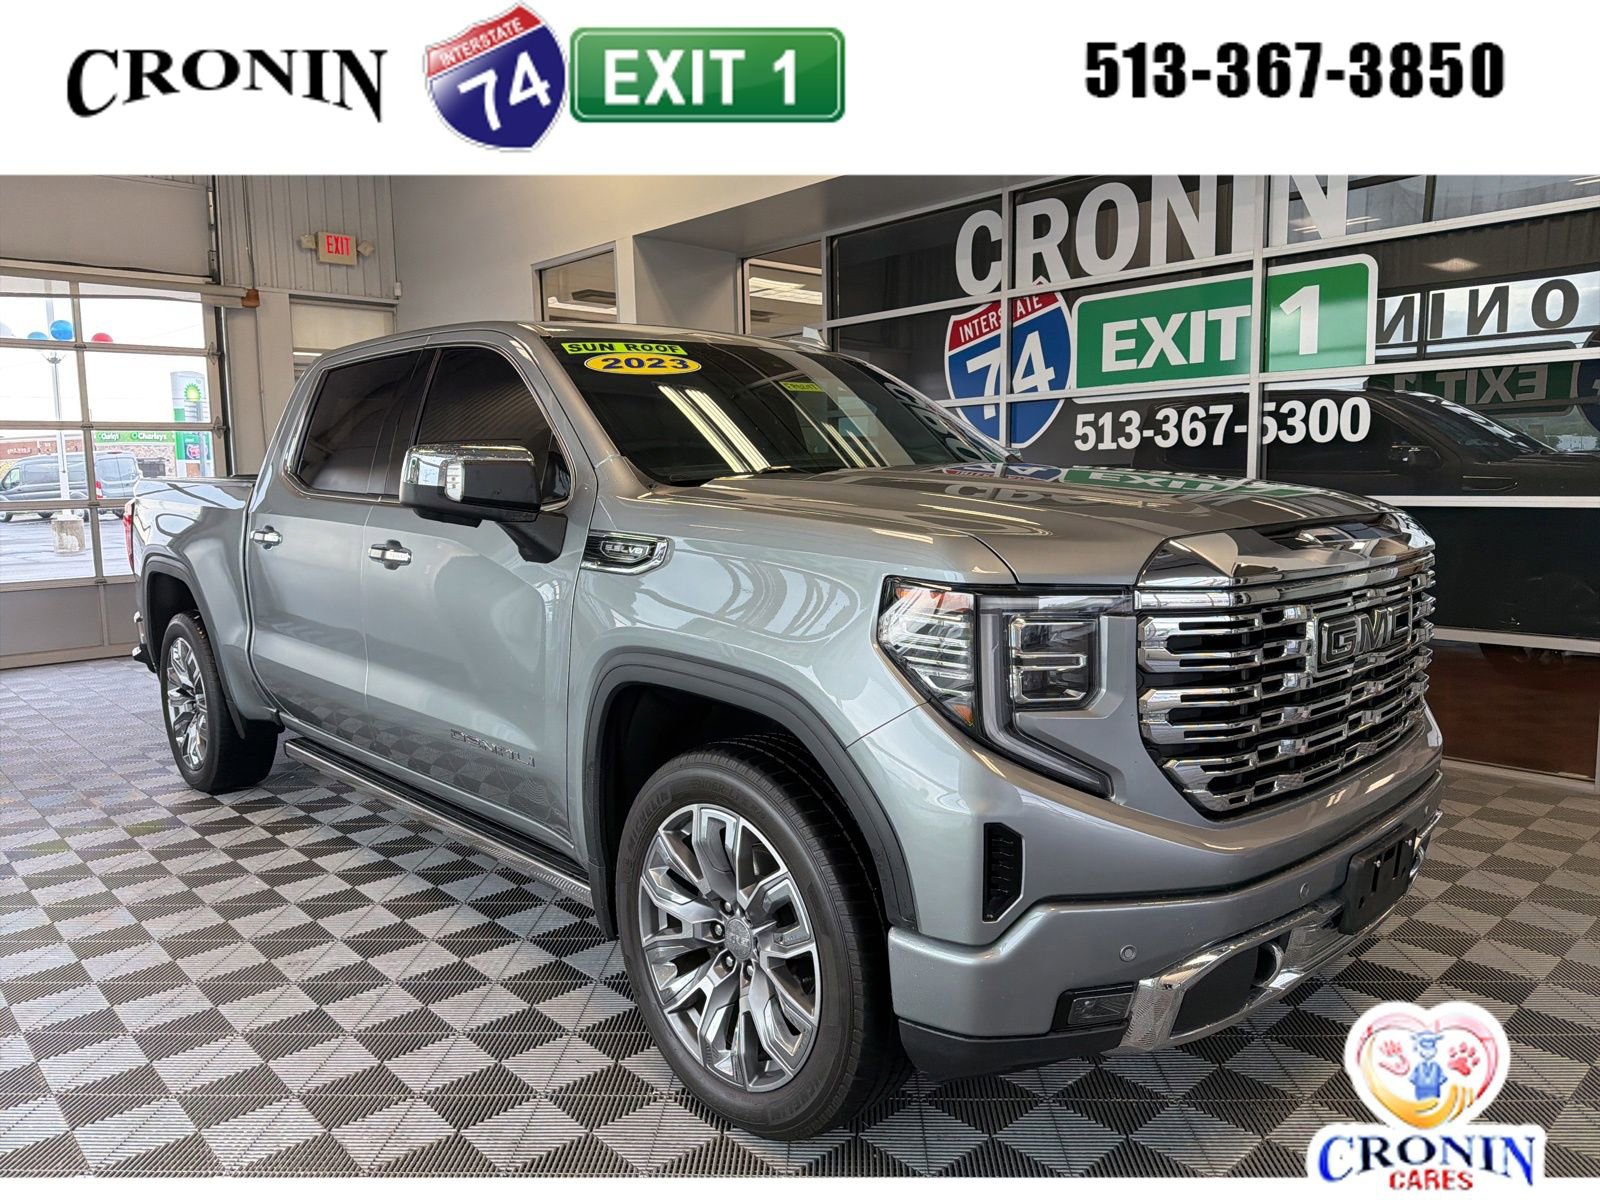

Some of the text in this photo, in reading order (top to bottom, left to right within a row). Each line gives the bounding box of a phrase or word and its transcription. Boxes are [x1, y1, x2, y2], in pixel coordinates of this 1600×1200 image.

[326, 234, 352, 257] EXIT
[955, 174, 1348, 298] CRONIN
[959, 294, 1043, 343] INTERATE
[1101, 285, 1320, 373] EXIT 1
[567, 342, 680, 354] SUN ROOF
[601, 357, 690, 370] 2023
[966, 331, 1056, 420] 74
[1074, 396, 1372, 452] 513-367-5300
[1319, 601, 1412, 665] GMC
